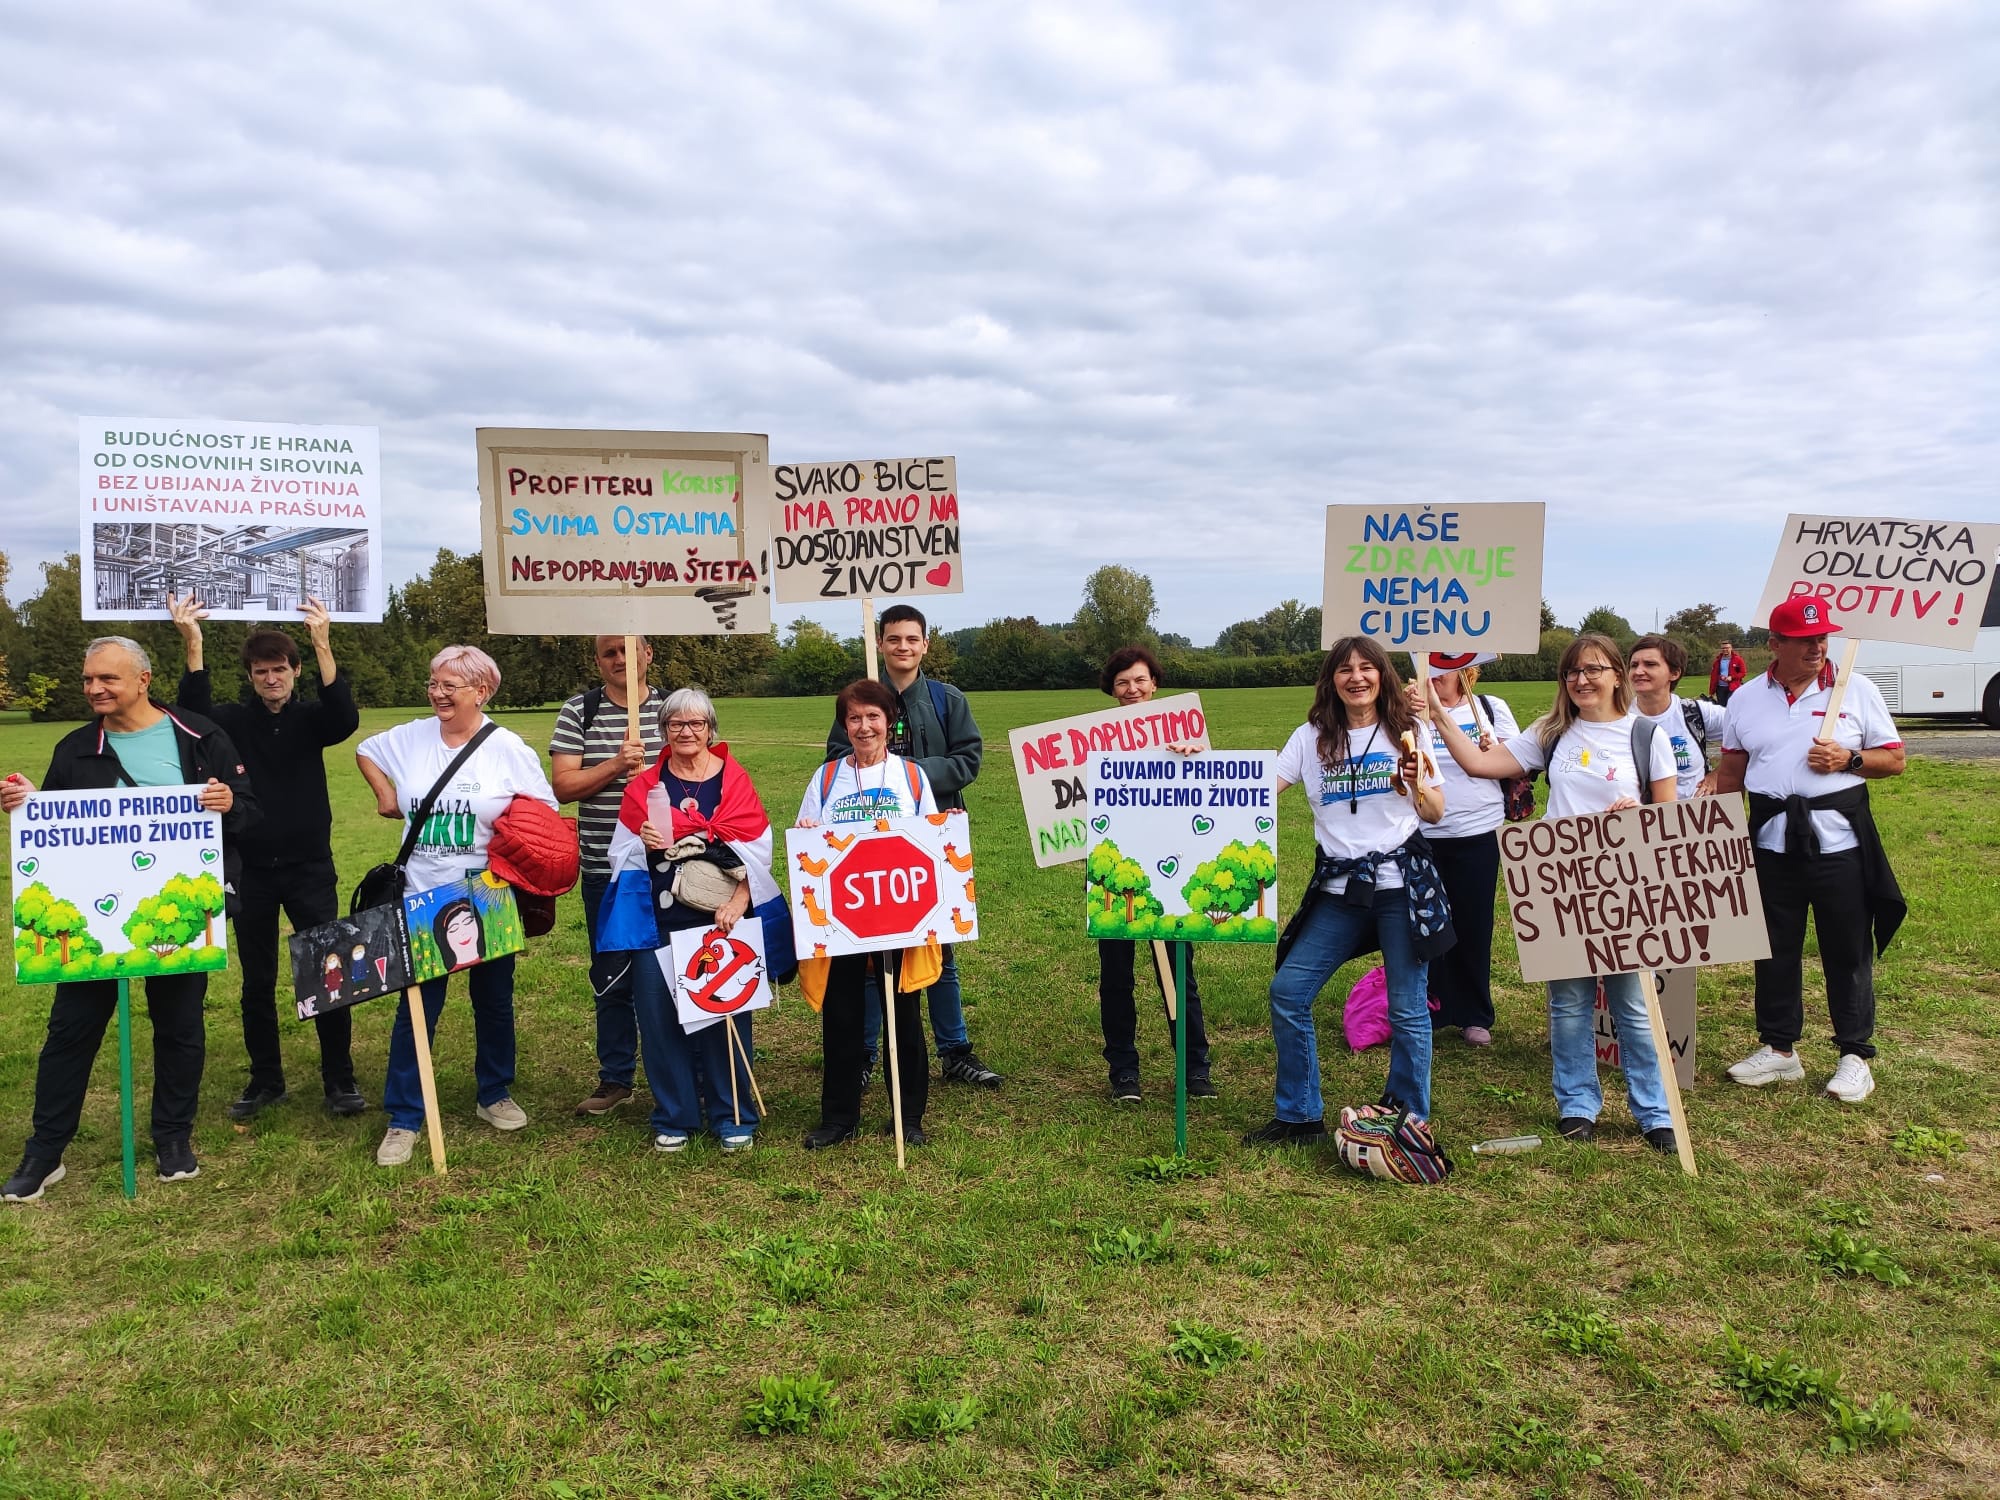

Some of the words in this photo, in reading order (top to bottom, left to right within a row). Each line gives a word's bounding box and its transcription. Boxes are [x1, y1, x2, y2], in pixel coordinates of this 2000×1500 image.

[104, 429, 245, 449] BUDUĆNOST
[250, 435, 272, 451] JE
[278, 437, 354, 453] HRANA
[93, 452, 127, 468] OD
[132, 453, 253, 472] OSNOVNIH
[259, 457, 364, 475] SIROVINA
[774, 462, 861, 501] SVAKO
[873, 459, 948, 491] BIĆE
[98, 474, 138, 490] BEZ
[144, 475, 245, 493] UBIJANJA
[250, 475, 360, 497] ŽIVOTINJA
[92, 497, 97, 512] I
[104, 494, 254, 514] UNIŠTAVANJA
[260, 499, 366, 518] PRAŠUMA
[511, 508, 599, 536] SVIMA
[784, 500, 835, 533] IMA
[843, 493, 920, 526] PRAVO
[929, 493, 959, 522] NA
[1363, 505, 1460, 543] NAŠE
[774, 524, 960, 570] DOSTOJANSTVEN
[1795, 520, 1975, 554] HRVATSKA
[819, 560, 928, 597] ŽIVOT
[1343, 544, 1517, 587] ZDRAVLJE
[1802, 549, 1986, 586] ODLUČNO
[1363, 576, 1469, 606] NEMA
[1360, 608, 1491, 645] CIJENU
[1021, 732, 1068, 775] NE
[1100, 757, 1176, 780] ČUVAMO
[1182, 760, 1263, 780] PRIRODU
[1366, 761, 1391, 775] NISU
[26, 798, 112, 821] ČUVAMO
[1094, 783, 1202, 807] POŠTUJEMO
[1208, 783, 1270, 807] ŽIVOTE
[20, 824, 142, 849] POŠTUJEMO
[149, 819, 215, 842] ŽIVOTE
[1638, 799, 1734, 844] PLIVA
[1507, 865, 1530, 898] U
[1537, 850, 1649, 895] SMEĆU,
[1653, 836, 1755, 881] FEKALIJE
[843, 866, 928, 910] STOP
[1513, 901, 1540, 942] S
[1553, 875, 1749, 937] MEGAFARMI
[1585, 924, 1711, 974] NEĆU!
[297, 995, 319, 1019] NE
